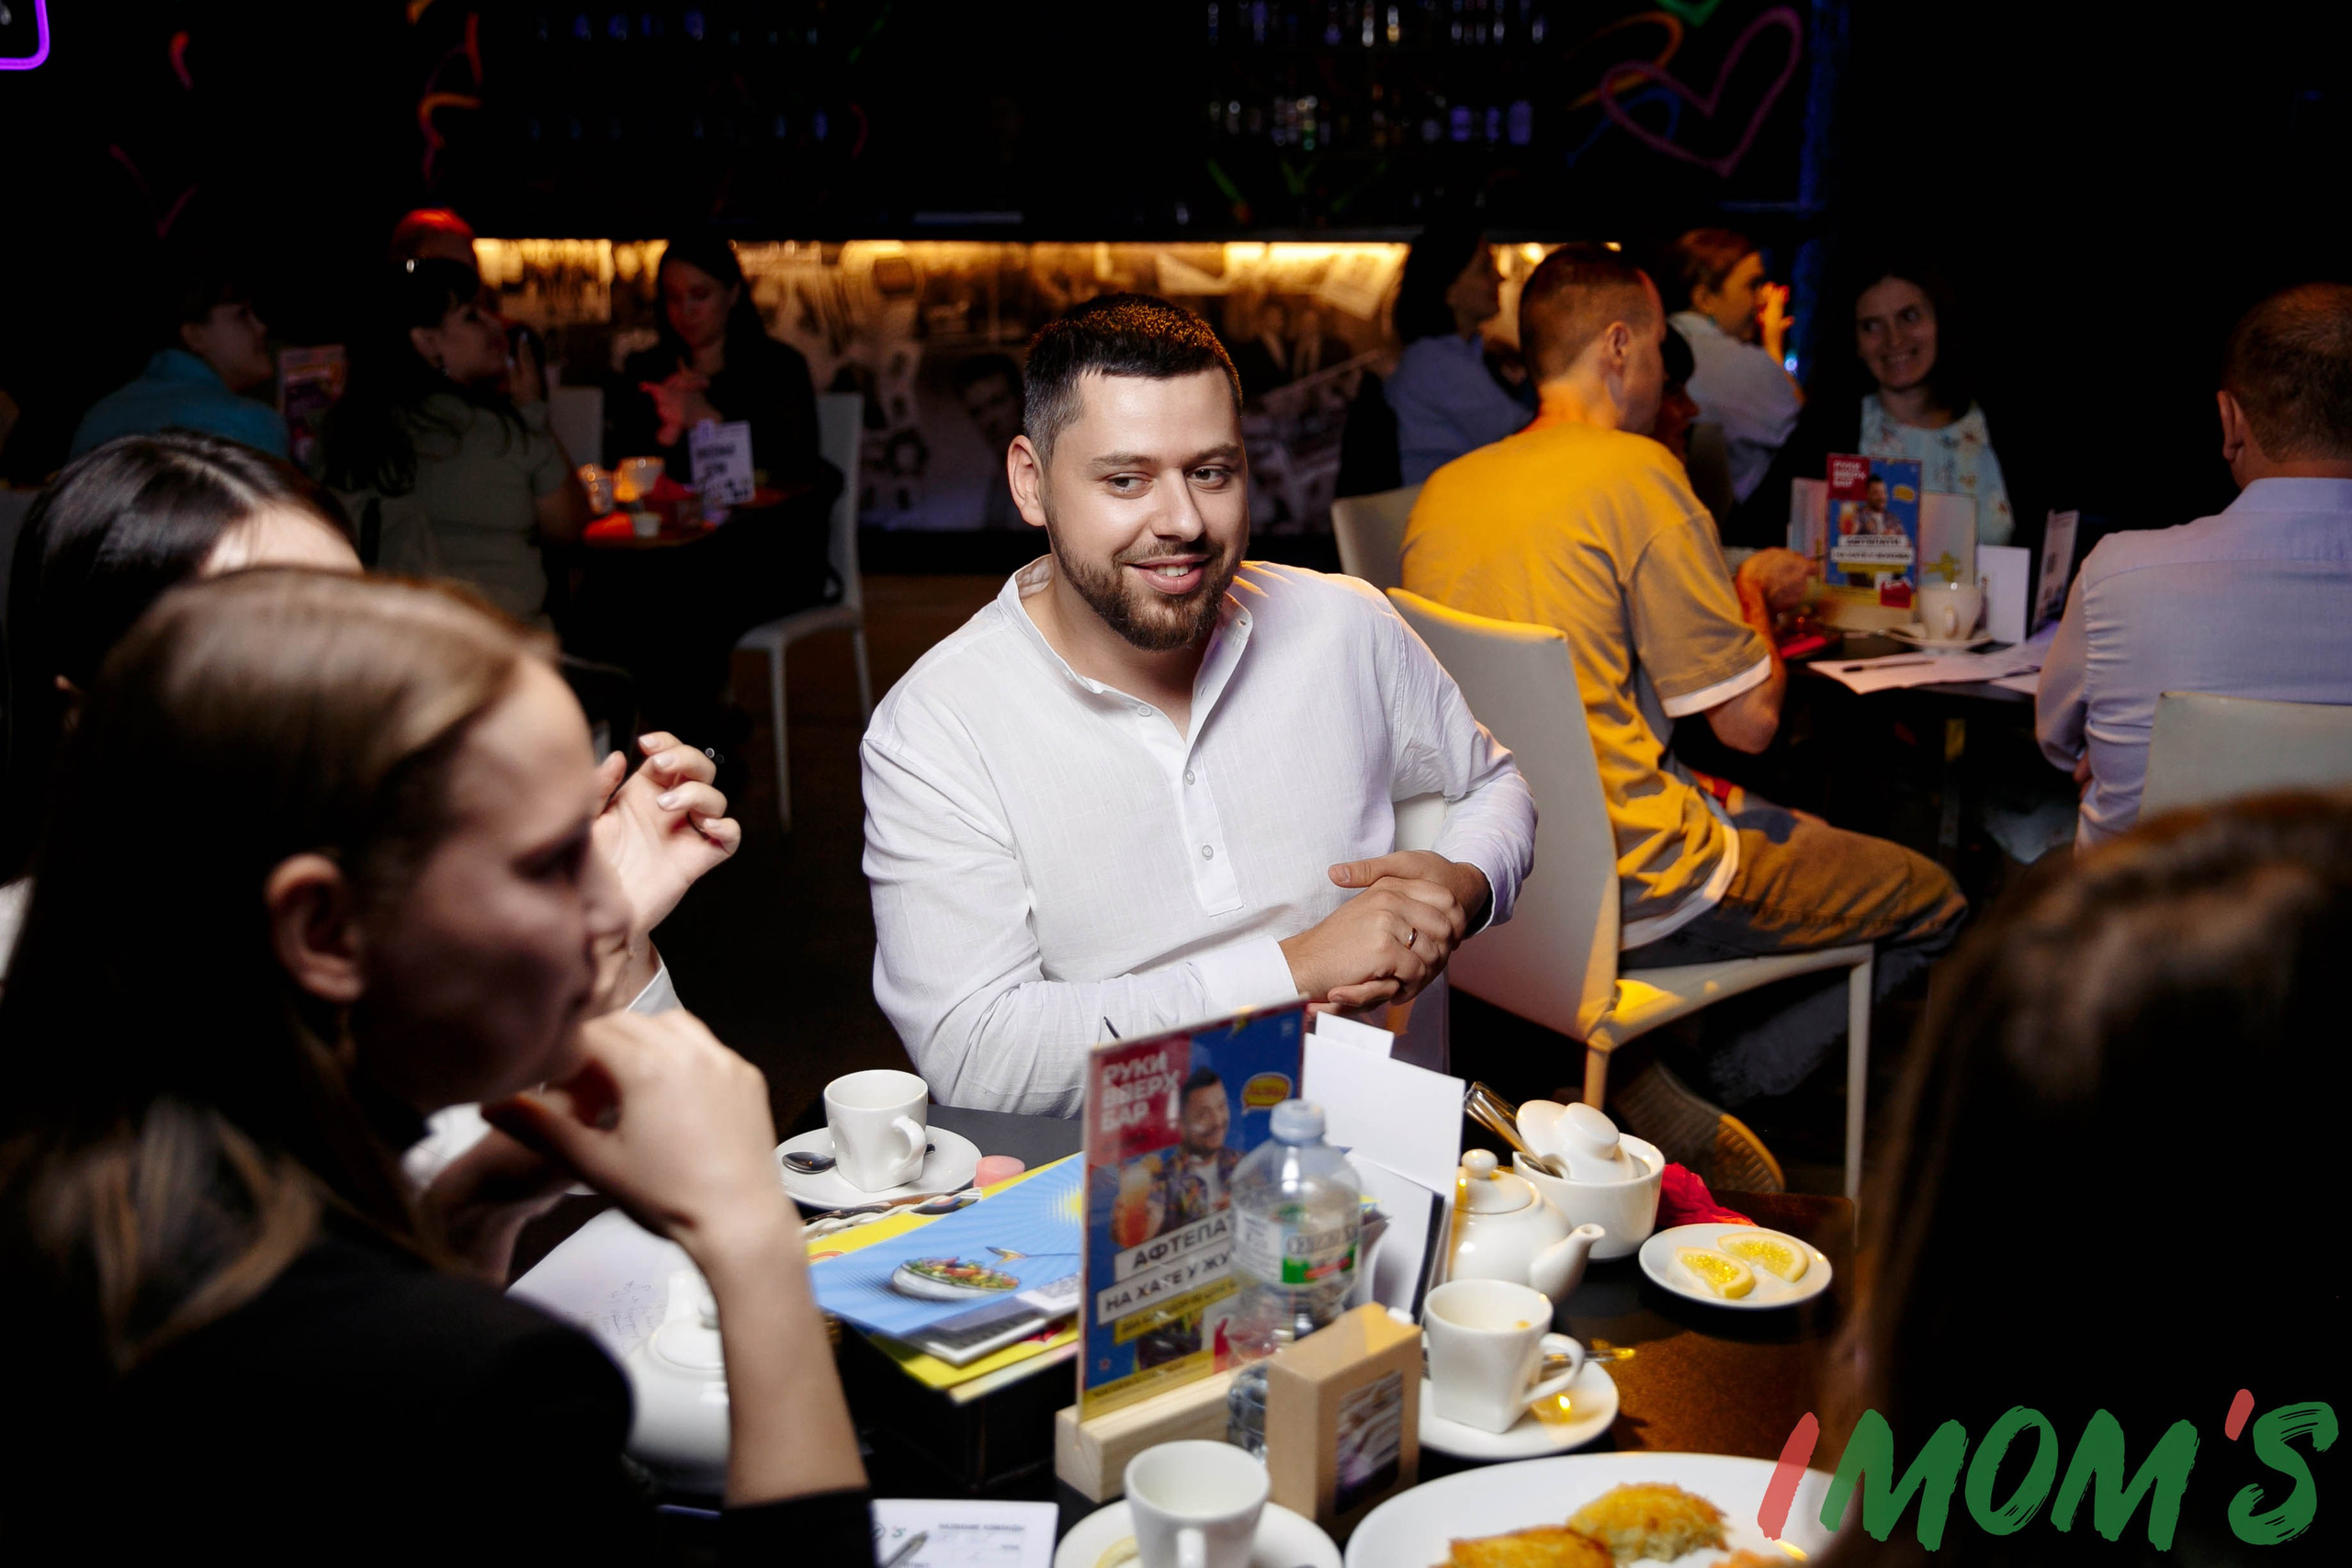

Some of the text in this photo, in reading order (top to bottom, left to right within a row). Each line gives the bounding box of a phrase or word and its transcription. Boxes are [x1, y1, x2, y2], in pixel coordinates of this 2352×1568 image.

[1102, 1051, 1168, 1084] РУКИ
[1102, 1100, 1149, 1133] БАР
[1133, 1215, 1230, 1269] АФТЕПА
[1106, 1291, 1132, 1312] НА
[1187, 1266, 1197, 1279] У
